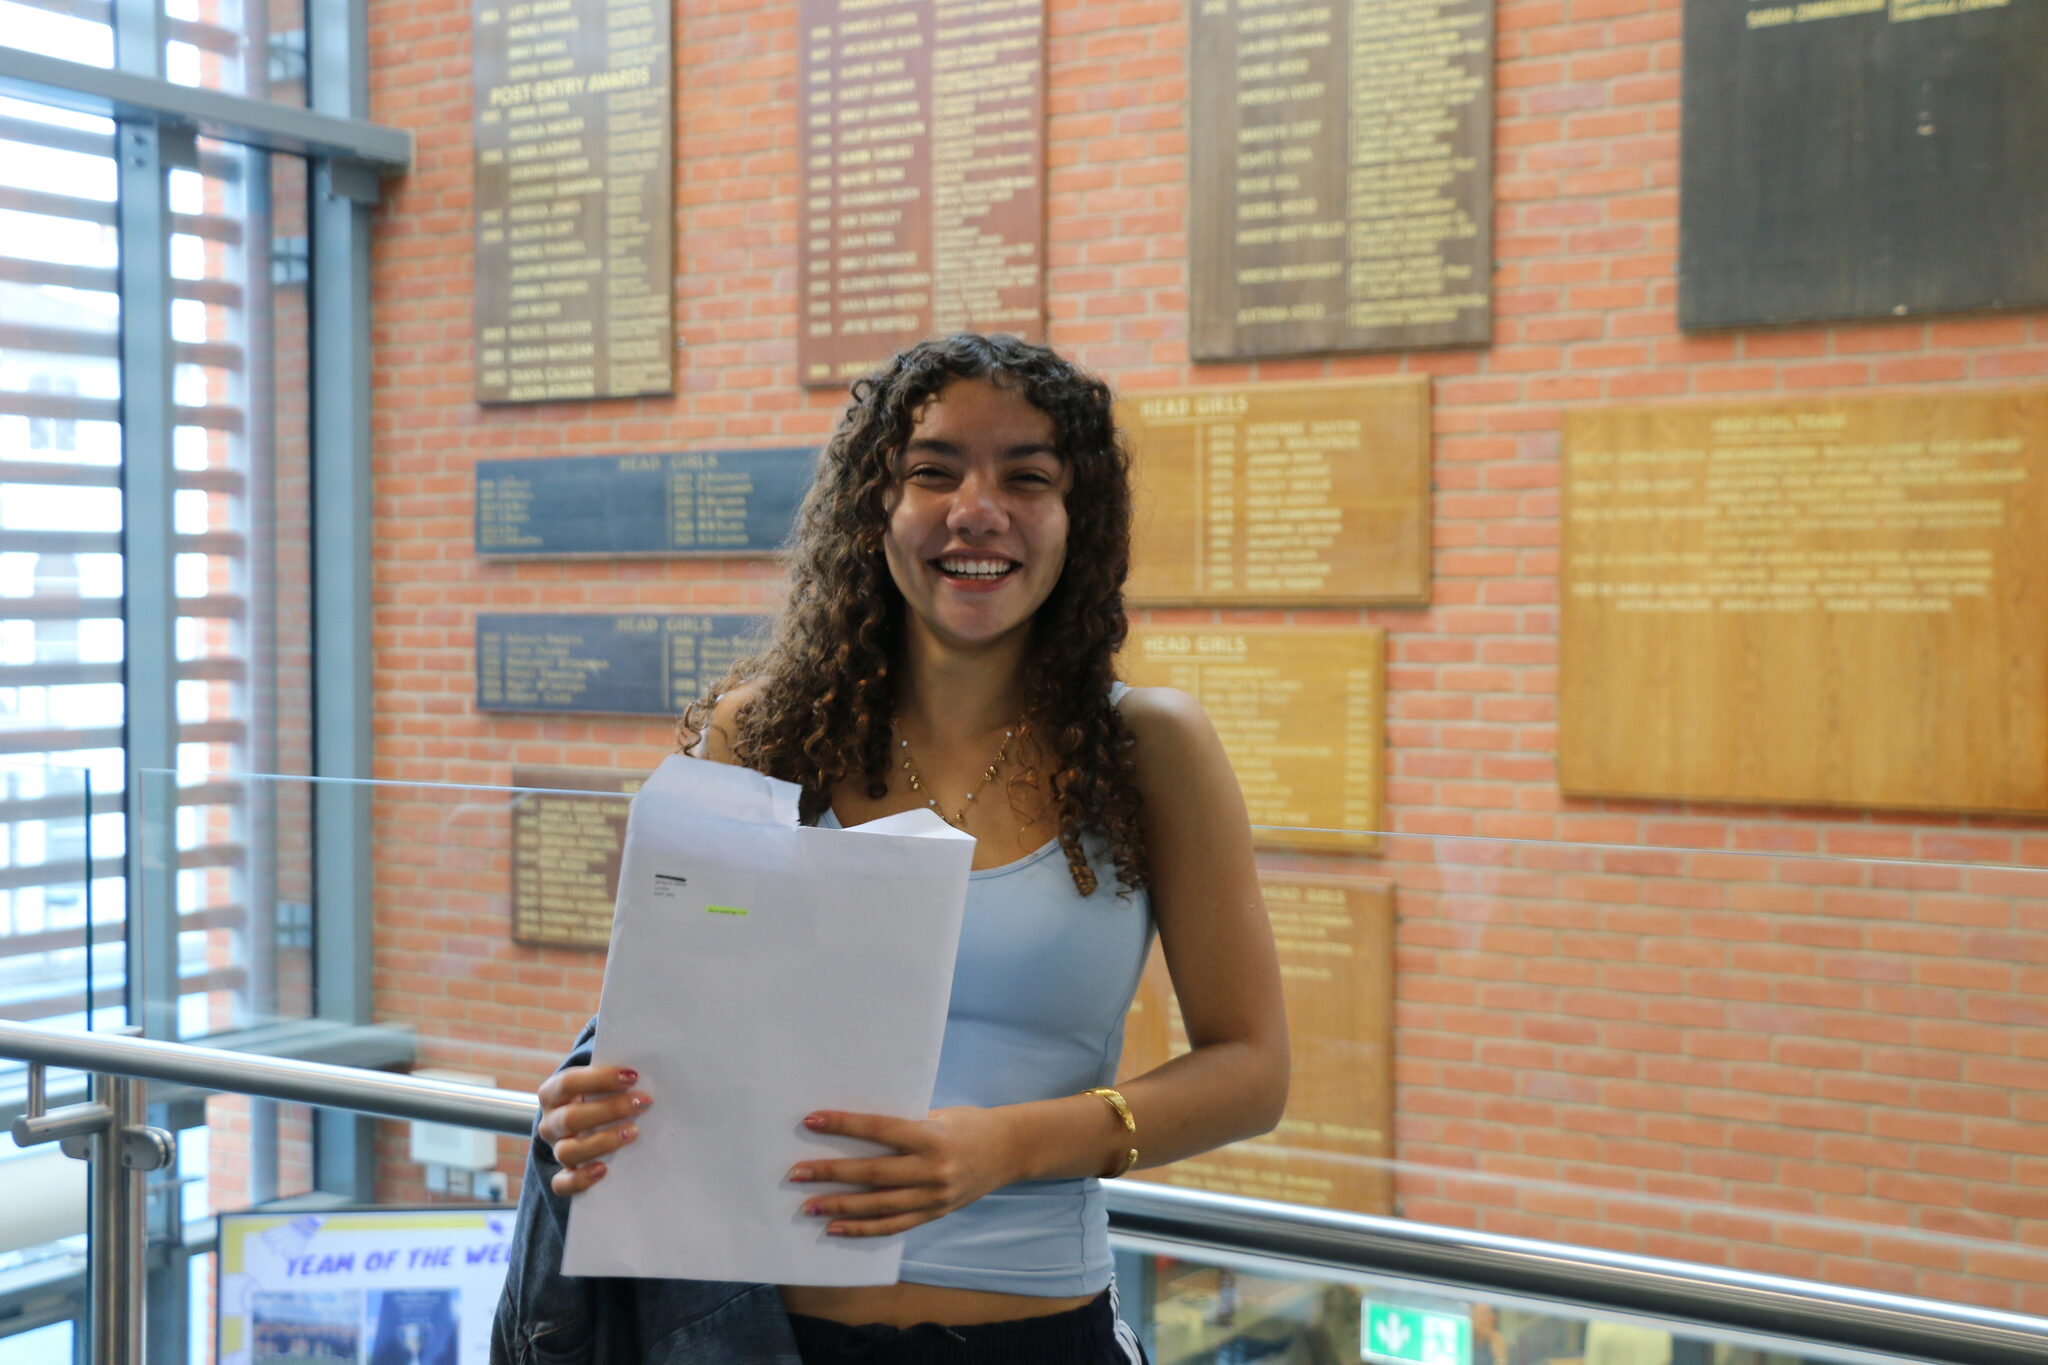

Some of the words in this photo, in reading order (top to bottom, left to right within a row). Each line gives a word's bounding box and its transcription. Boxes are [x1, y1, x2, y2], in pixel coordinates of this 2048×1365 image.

[490, 83, 531, 106] POST
[534, 76, 585, 101] ENTRY
[588, 66, 649, 92] AWARDS
[1140, 399, 1190, 417] HEAD
[1195, 395, 1248, 415] GIRLS
[619, 456, 661, 471] HEAD
[671, 454, 718, 469] GIRLS
[616, 618, 658, 632] HEAD
[666, 617, 713, 632] GIRLS
[1144, 636, 1192, 653] HEAD
[1195, 636, 1247, 654] GIRLS
[286, 1253, 354, 1277] TEAM
[364, 1251, 400, 1272] OF
[408, 1247, 453, 1270] THE
[466, 1244, 511, 1265] WE
